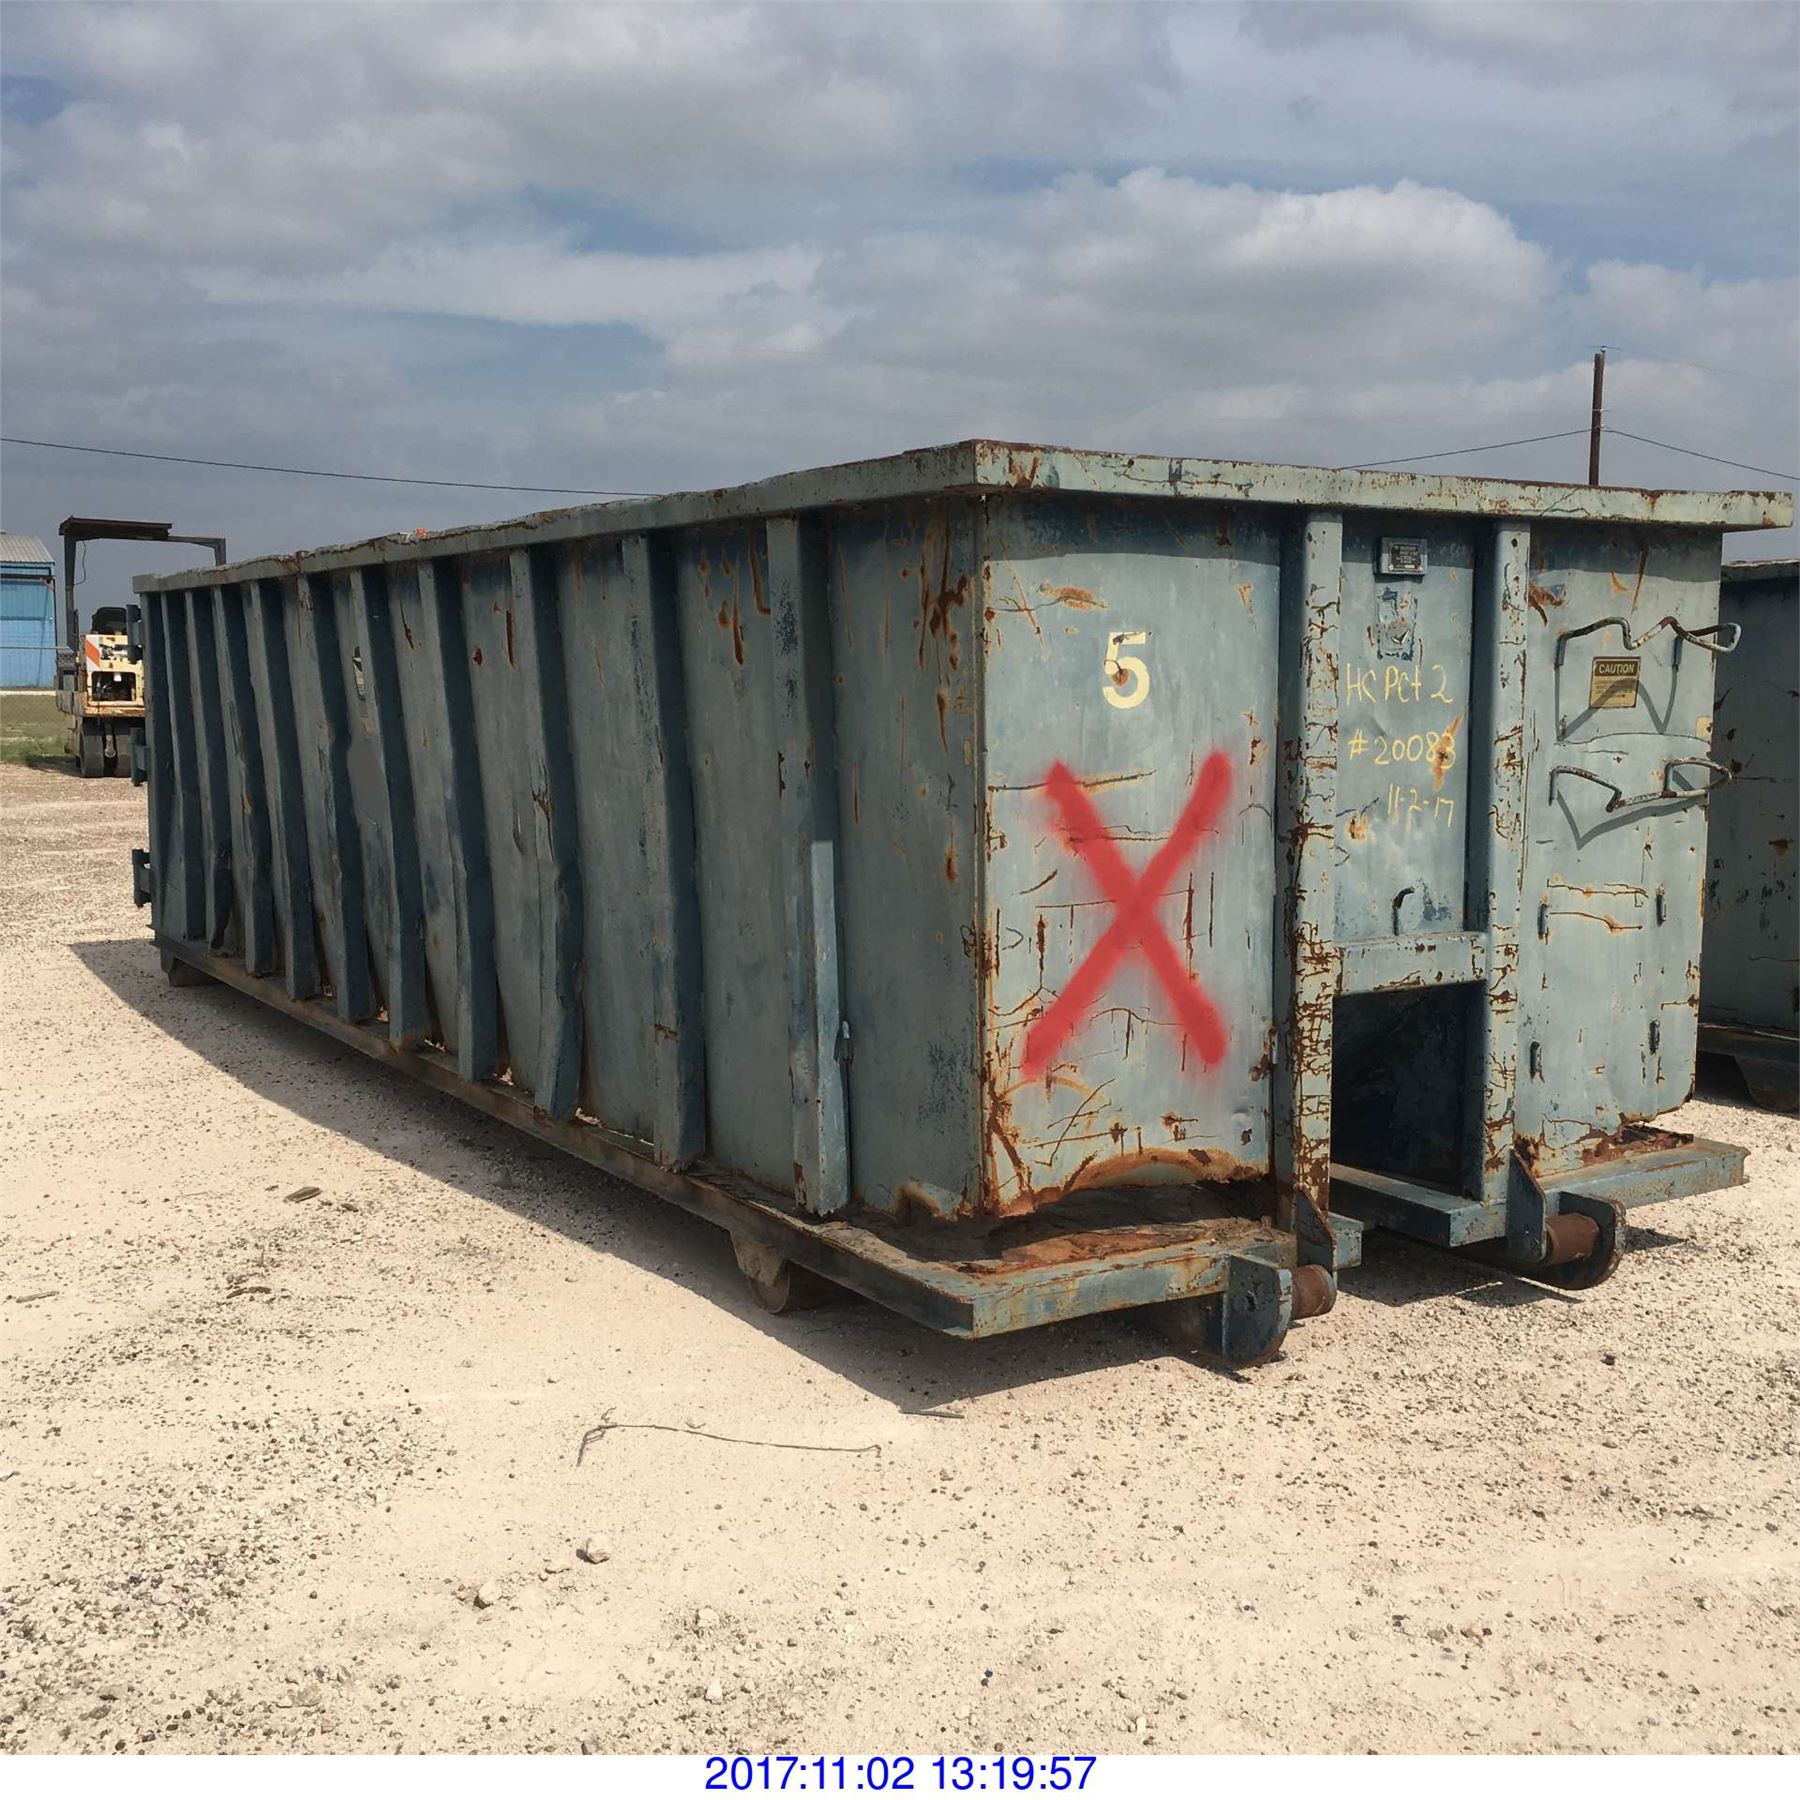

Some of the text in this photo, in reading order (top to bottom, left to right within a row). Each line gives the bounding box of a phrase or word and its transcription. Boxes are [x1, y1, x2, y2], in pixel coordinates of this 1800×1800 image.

[1102, 631, 1150, 709] 5
[1346, 662, 1377, 706] HC
[1430, 664, 1453, 703] 2
[1599, 663, 1635, 674] CAUTION
